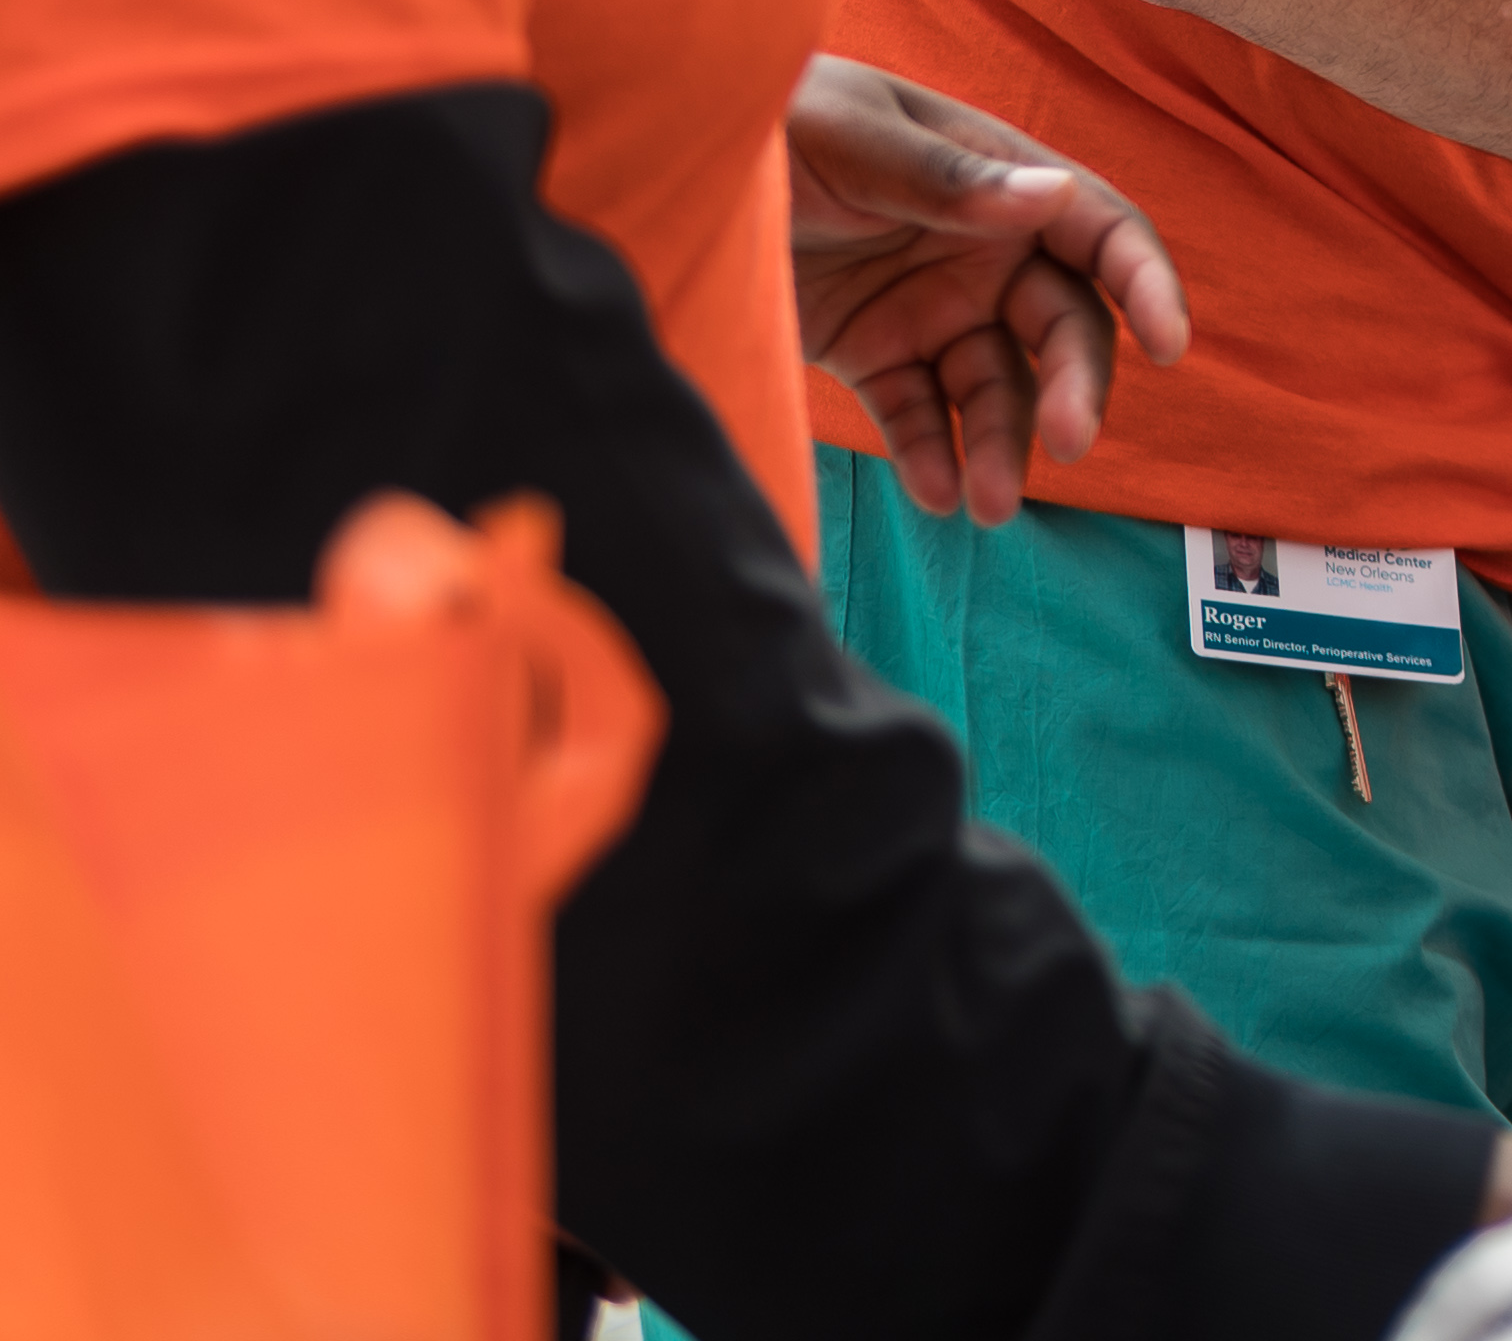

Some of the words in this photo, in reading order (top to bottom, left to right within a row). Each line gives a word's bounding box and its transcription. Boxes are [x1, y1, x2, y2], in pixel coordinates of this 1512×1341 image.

[1324, 545, 1381, 564] Medical
[1384, 552, 1433, 569] Center
[1325, 561, 1356, 577] New
[1360, 565, 1416, 584] Orleans
[1326, 576, 1357, 589] LCMC
[1359, 580, 1394, 593] Health
[1204, 605, 1267, 631] Roger
[1205, 631, 1222, 644] RN
[1224, 633, 1260, 648] Senior
[1263, 638, 1310, 656] Director,
[1312, 644, 1384, 663] Perioperative
[1386, 652, 1433, 668] Services
